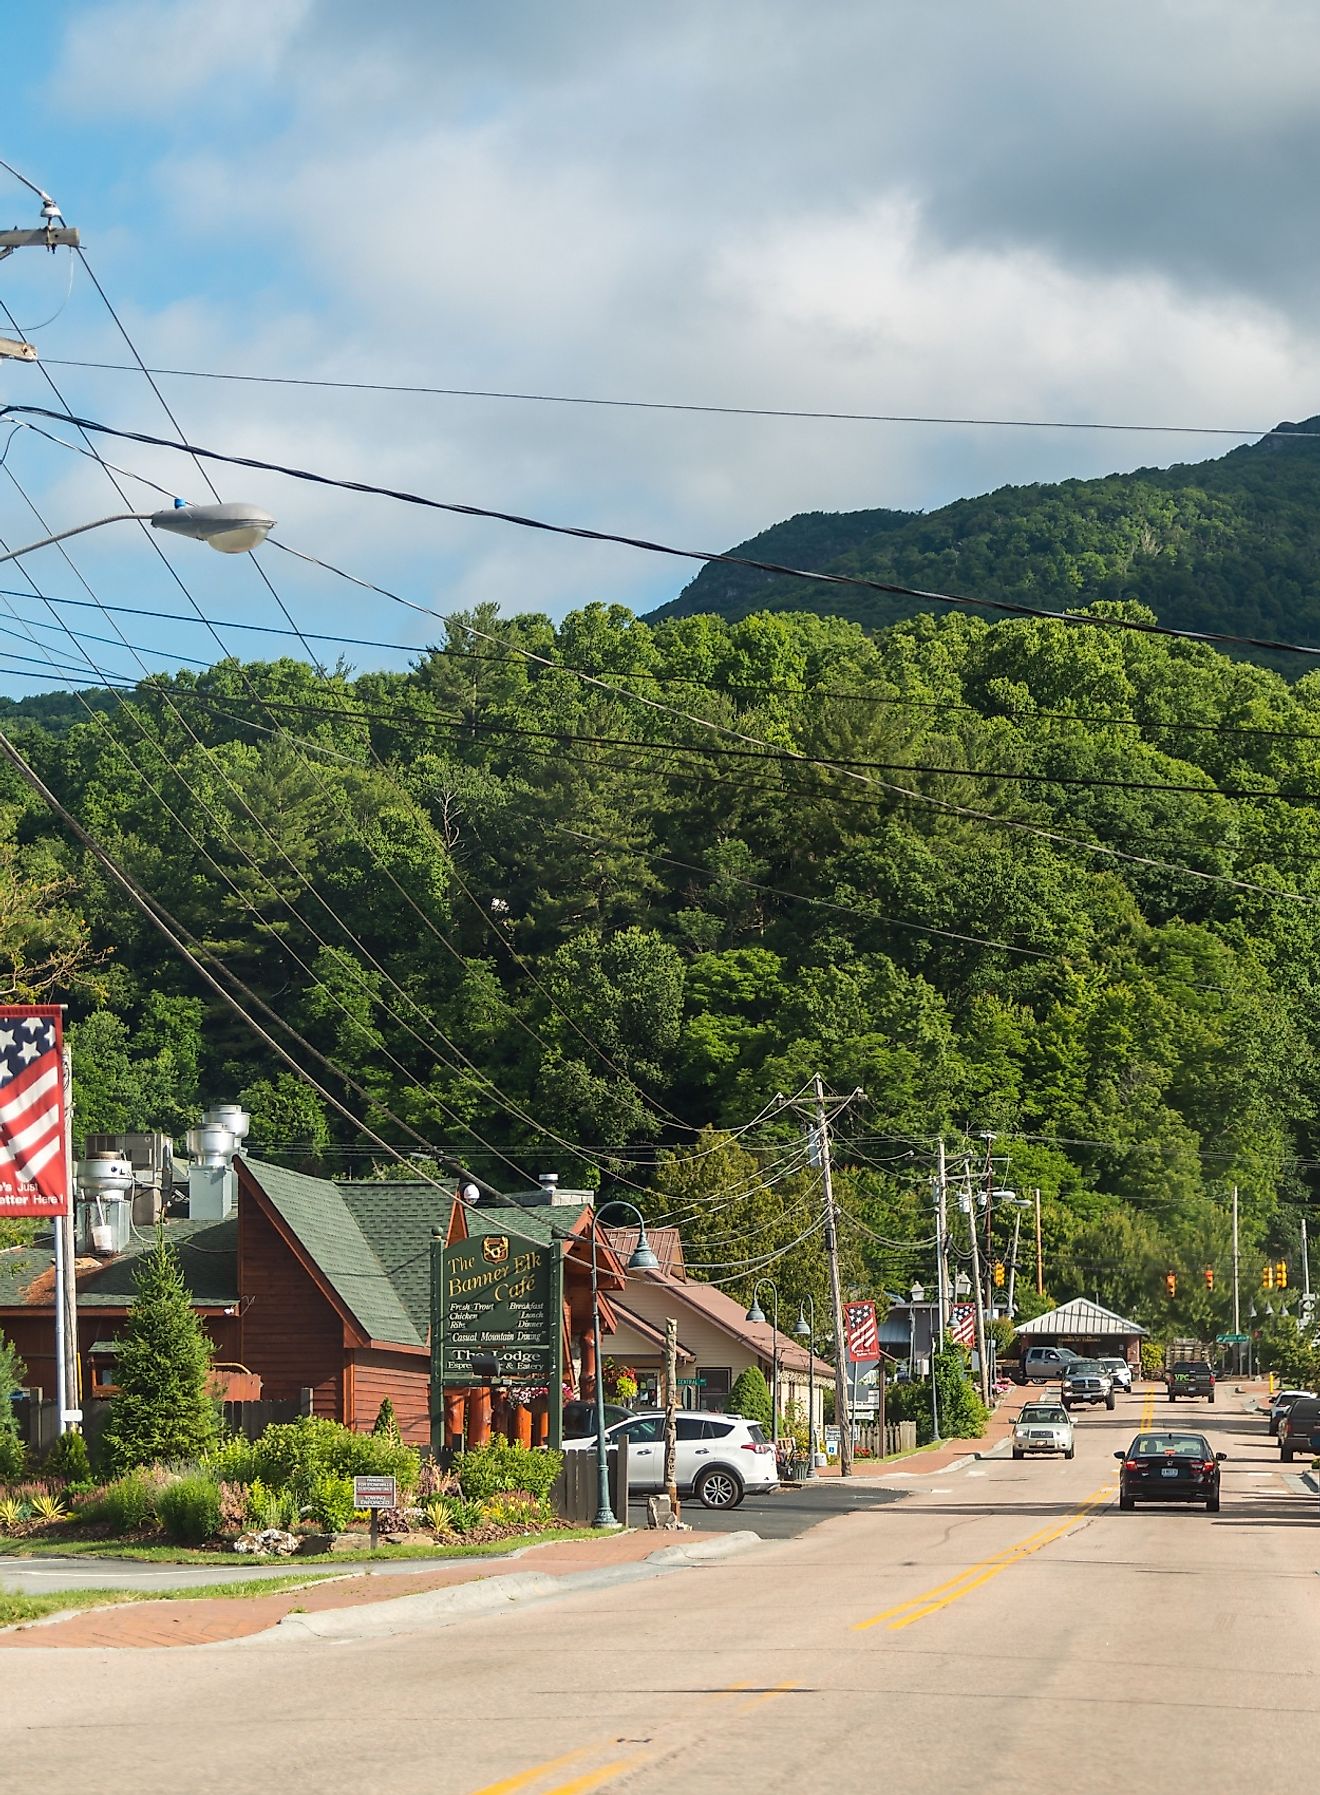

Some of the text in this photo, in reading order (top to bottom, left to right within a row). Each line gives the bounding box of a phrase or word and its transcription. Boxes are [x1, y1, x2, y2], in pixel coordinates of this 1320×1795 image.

[17, 1182, 38, 1192] Just
[448, 1256, 475, 1275] The
[448, 1252, 542, 1298] Banner Elk
[494, 1273, 536, 1302] Café
[450, 1303, 494, 1312] Fresh Trout
[509, 1302, 544, 1310] Breakfast
[449, 1312, 478, 1320] Chicken
[520, 1311, 544, 1319] Lunch
[450, 1321, 466, 1329] Ribs
[518, 1320, 543, 1328] Dinner
[481, 1331, 515, 1342] Mountain
[517, 1362, 544, 1371] Eatery
